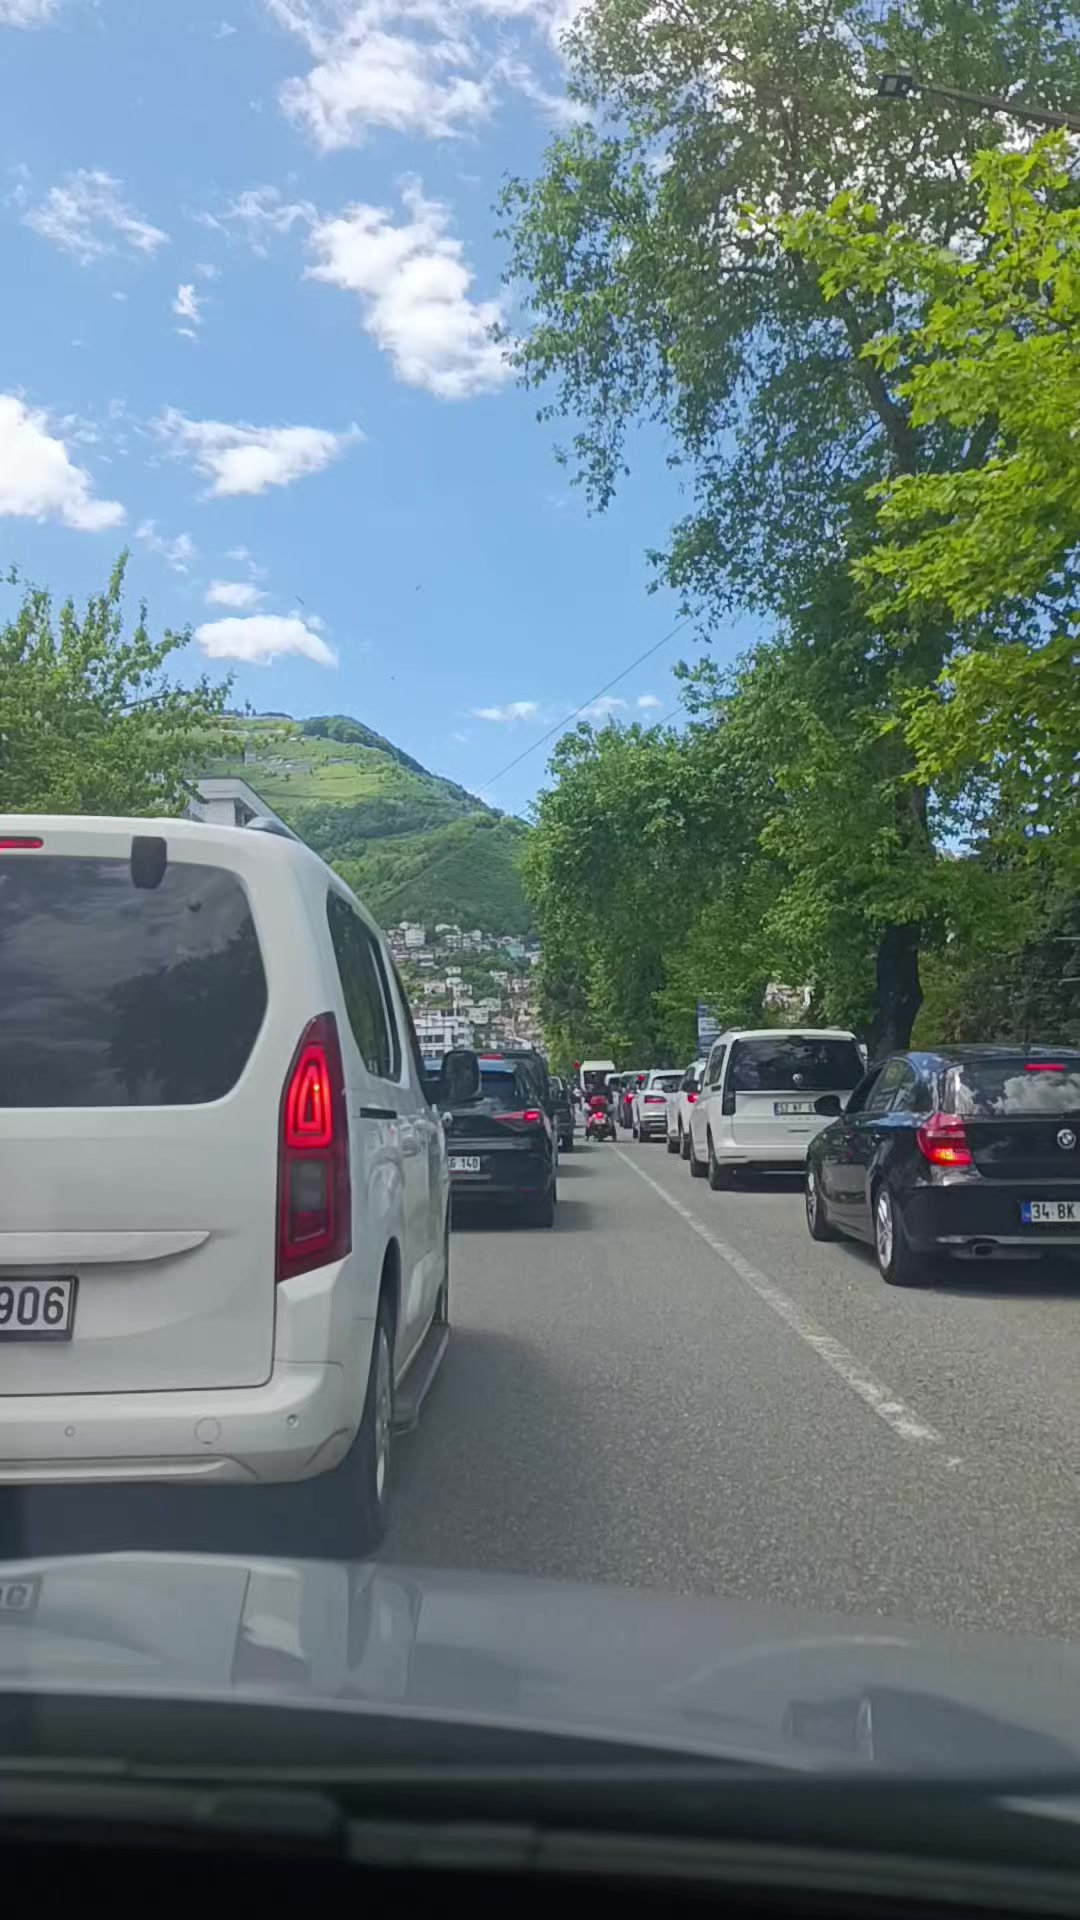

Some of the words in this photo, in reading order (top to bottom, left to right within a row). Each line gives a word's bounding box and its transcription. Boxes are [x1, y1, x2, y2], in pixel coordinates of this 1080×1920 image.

[461, 1157, 479, 1169] 140
[1032, 1203, 1050, 1219] 34
[1057, 1203, 1075, 1219] BK
[0, 1286, 65, 1326] 906
